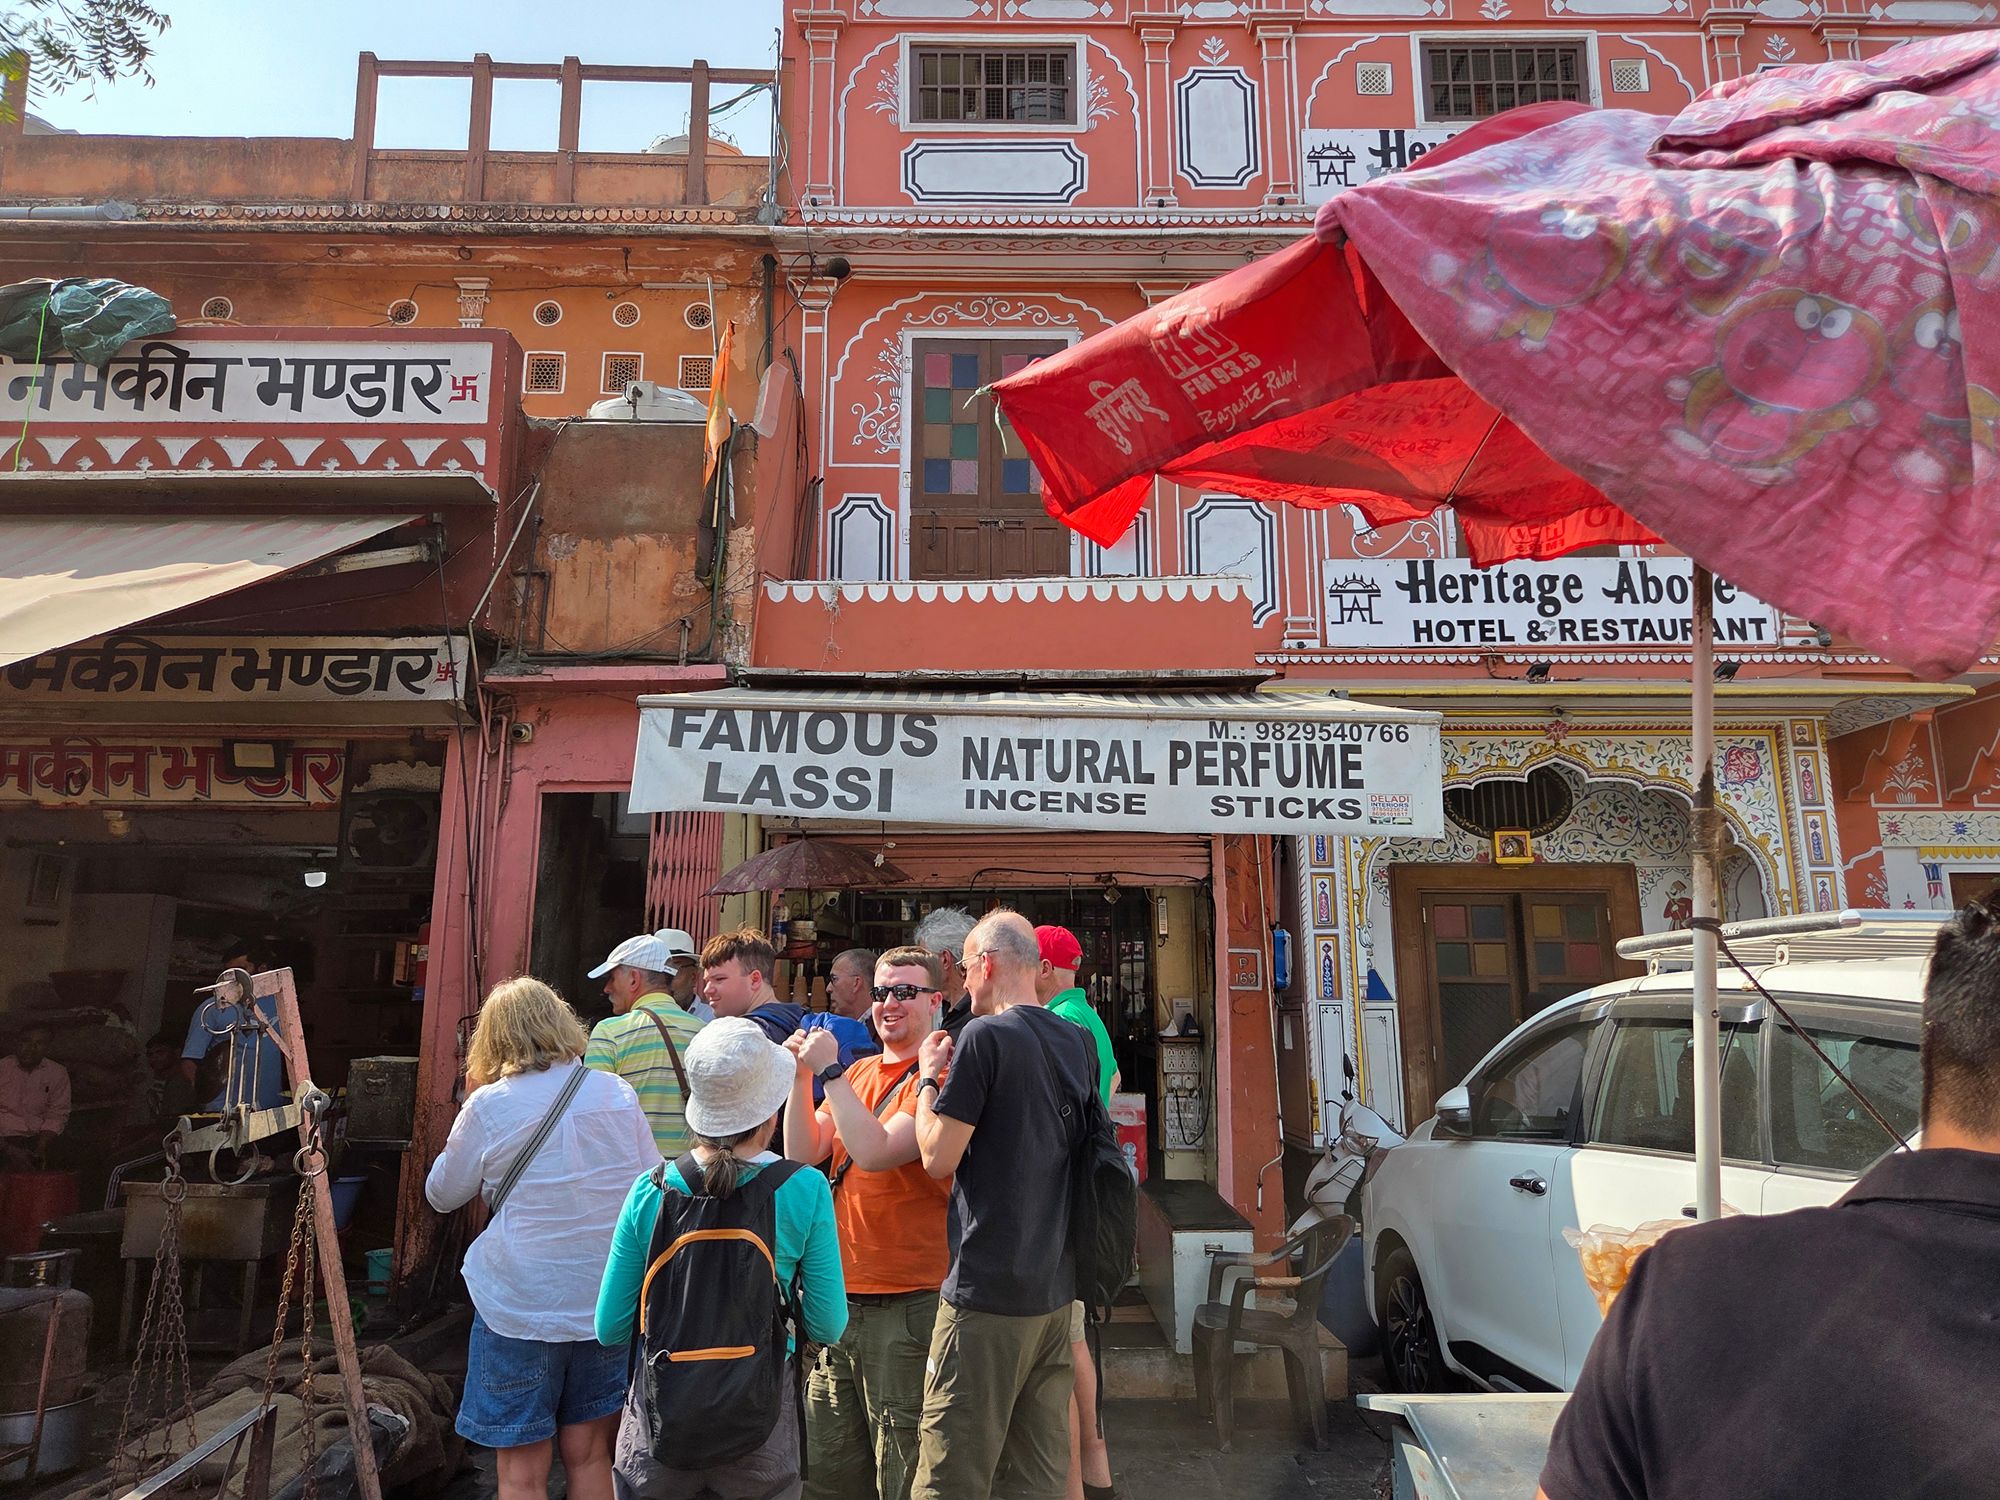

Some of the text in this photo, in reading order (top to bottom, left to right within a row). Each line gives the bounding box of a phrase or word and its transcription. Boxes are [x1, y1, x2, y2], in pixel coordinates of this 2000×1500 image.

[8, 342, 451, 417] नमकीन भण्डार
[1181, 352, 1262, 401] FM 93.5
[1395, 560, 1736, 618] Heritage Aboe
[1413, 619, 1515, 643] HOTEL
[231, 647, 438, 695] भण्डार
[667, 709, 938, 758] FAMOUS
[1255, 721, 1410, 743] 9829540766
[702, 761, 894, 813] LASSI
[962, 736, 1365, 790] NATURAL PERFUME
[965, 789, 1362, 821] INCENSE STICKS
[1370, 795, 1409, 803] DELADI
[1235, 972, 1257, 985] 169
[1238, 957, 1248, 969] P
